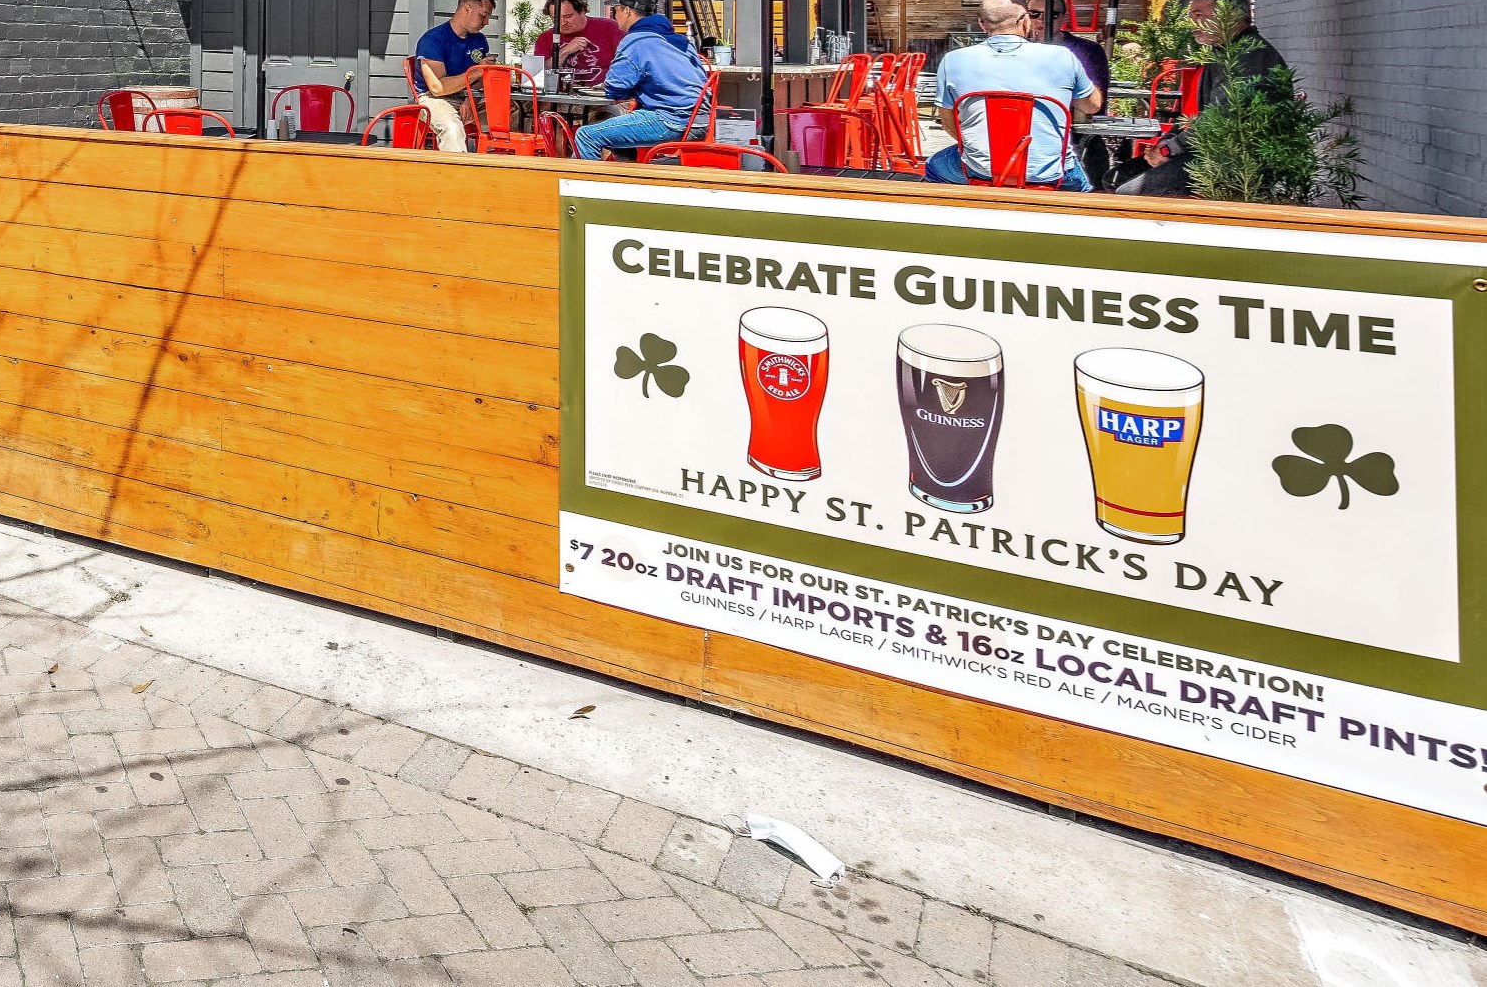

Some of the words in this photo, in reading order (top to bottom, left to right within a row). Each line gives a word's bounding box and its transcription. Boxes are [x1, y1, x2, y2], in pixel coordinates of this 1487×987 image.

[612, 239, 877, 300] CELEBRATE
[893, 265, 1200, 334] GUINNESS
[1218, 295, 1398, 356] TIME
[767, 384, 784, 396] RED
[785, 388, 801, 397] ALE
[916, 408, 985, 428] GUINNESS
[1100, 410, 1181, 438] HARP
[1119, 434, 1158, 446] LAGER
[681, 468, 806, 513] HAPPY
[825, 497, 884, 531] ST.
[904, 511, 1148, 581] PATRICK'S
[1174, 561, 1284, 607] DAY
[570, 539, 594, 561] $7
[666, 562, 763, 602] DRAFT
[772, 586, 915, 639] IMPORTS
[925, 623, 948, 646] &
[1035, 647, 1168, 697] LOCAL
[1179, 679, 1325, 733] DRAFT
[663, 542, 710, 564] JOIN
[715, 552, 744, 571] US
[749, 562, 794, 583] FOR
[799, 572, 849, 596] OUR
[855, 585, 890, 606] ST.
[897, 593, 1029, 636] PATRICK'S
[1037, 623, 1094, 650] DAY
[1102, 639, 1325, 702] CELEBRATION!
[680, 590, 755, 618] GUINNESS
[771, 613, 814, 631] HARP
[819, 623, 874, 651] LAGER
[891, 641, 1008, 680] SMITHWICK'S
[1013, 670, 1051, 689] RED
[1057, 681, 1095, 700] ALE
[1116, 694, 1224, 731] MAGNER'S
[1230, 721, 1297, 750] CIDER
